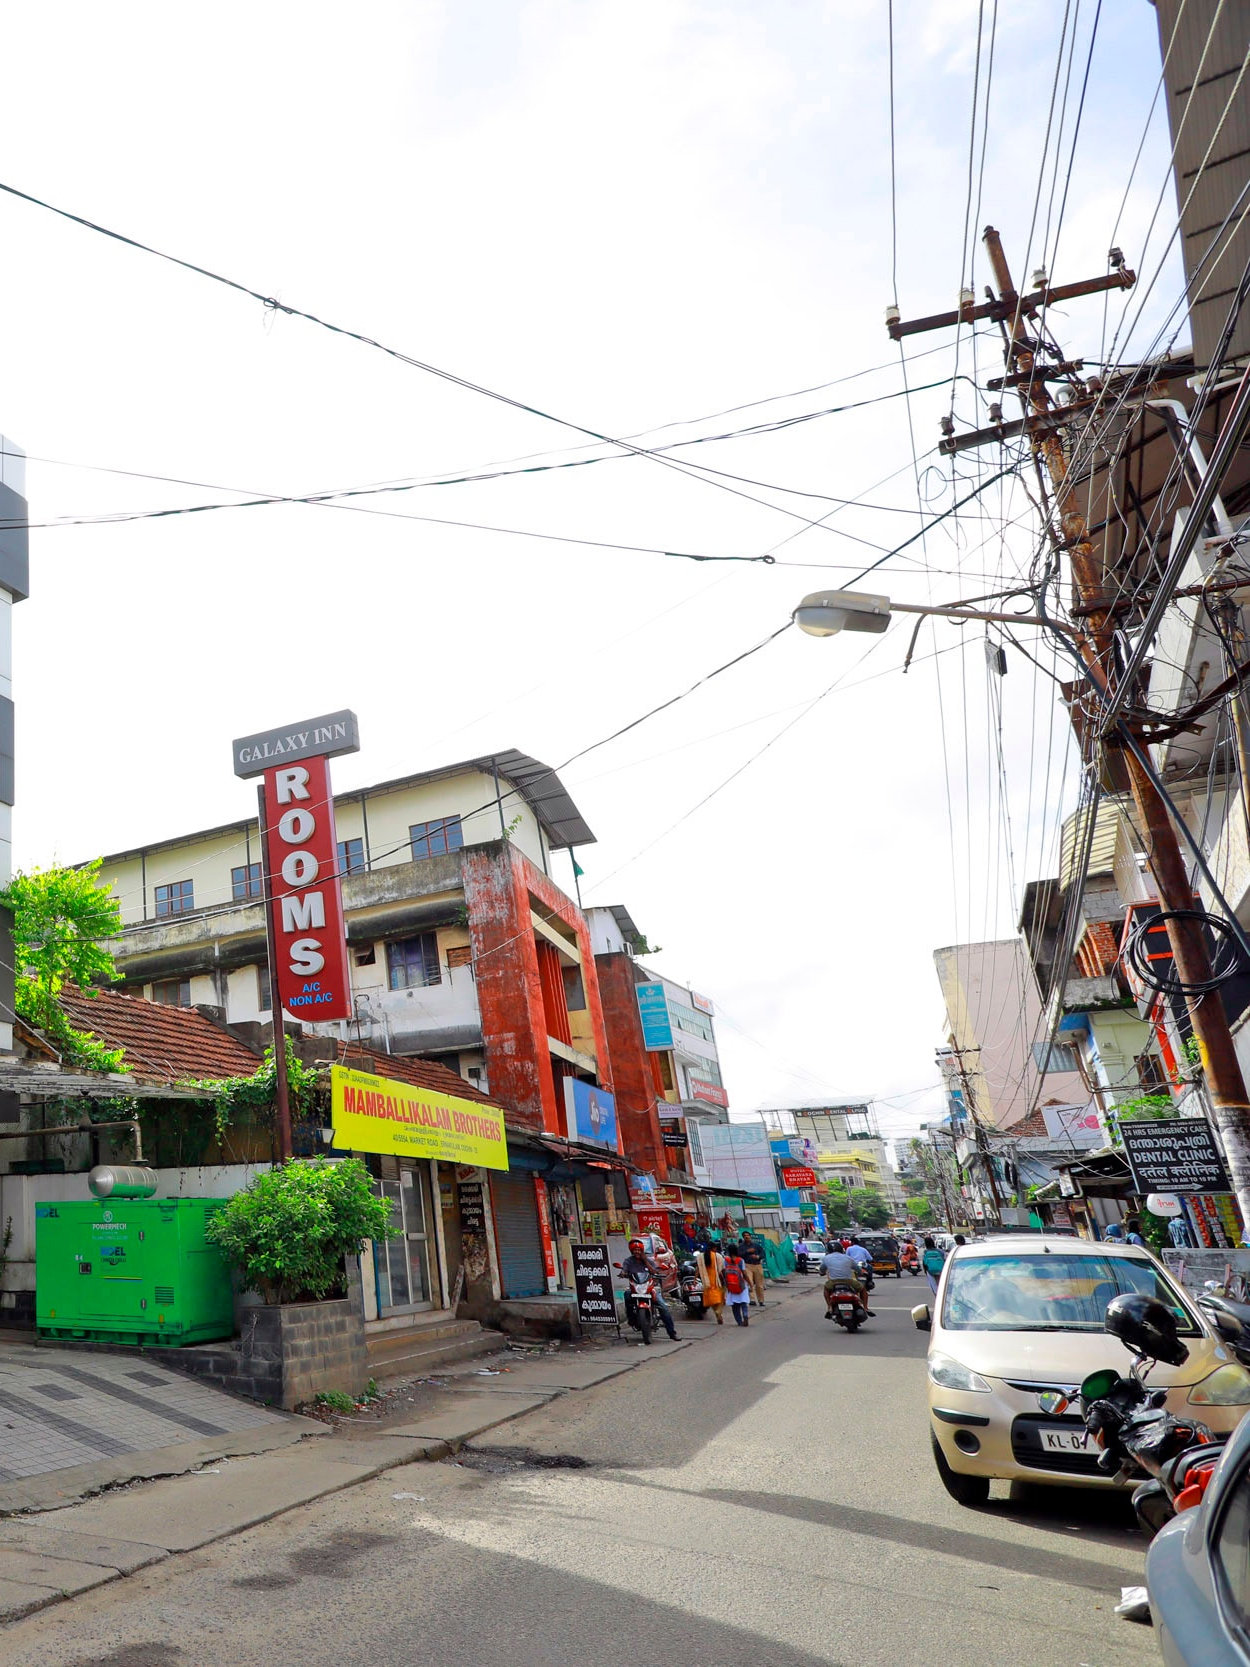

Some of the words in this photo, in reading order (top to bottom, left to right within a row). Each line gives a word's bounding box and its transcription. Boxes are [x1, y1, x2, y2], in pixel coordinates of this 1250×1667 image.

[238, 731, 309, 765] GALAXY
[314, 721, 347, 744] INN
[275, 765, 326, 977] ROOMS
[302, 981, 320, 993] A/C
[289, 994, 313, 1007] NON
[314, 991, 333, 1004] A/C
[343, 1085, 452, 1132] MAMBALLIKALAM
[453, 1110, 502, 1142] BROTHERS
[1124, 1129, 1132, 1137] 24
[1133, 1128, 1146, 1136] HRS
[1147, 1126, 1188, 1136] EMERGENCY
[1132, 1151, 1177, 1163] DENTAL
[1177, 1149, 1216, 1161] CLINIC
[648, 1221, 661, 1230] 4G
